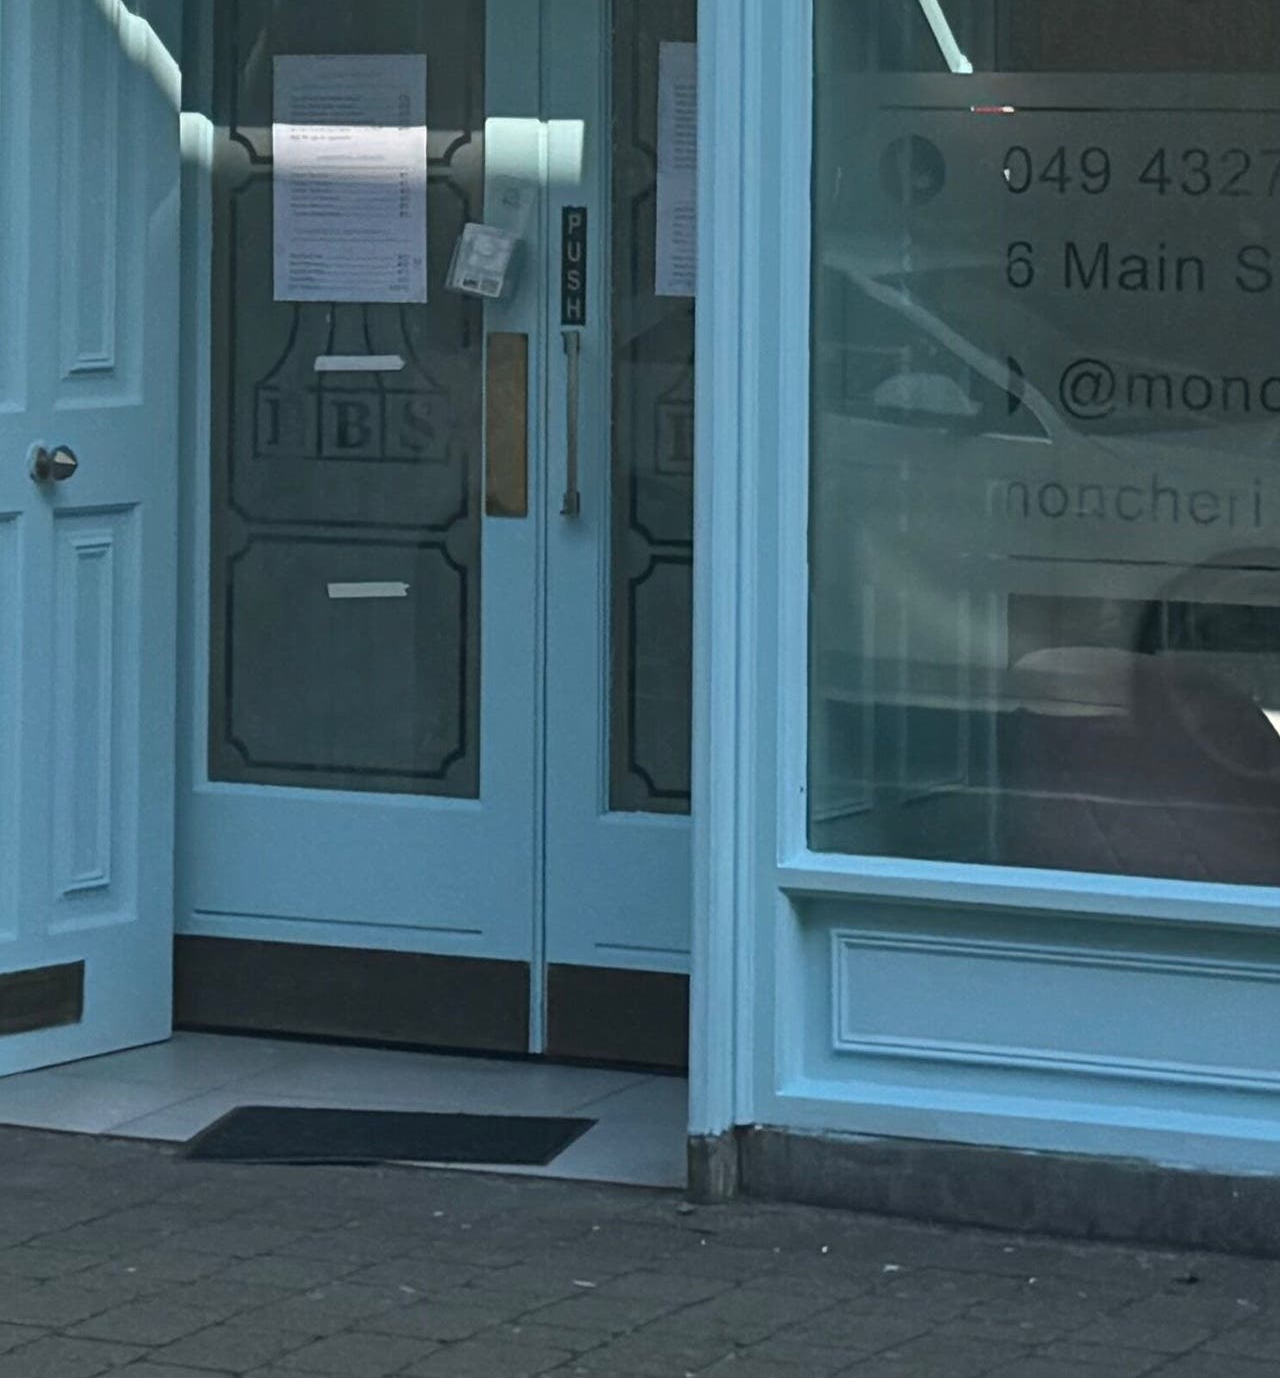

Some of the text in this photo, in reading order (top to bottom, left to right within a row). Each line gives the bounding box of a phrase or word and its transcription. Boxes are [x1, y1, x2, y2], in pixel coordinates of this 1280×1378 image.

[1002, 144, 1113, 196] 049
[565, 212, 583, 321] PUSH
[1005, 240, 1036, 291] 6
[1063, 241, 1207, 293] Main
